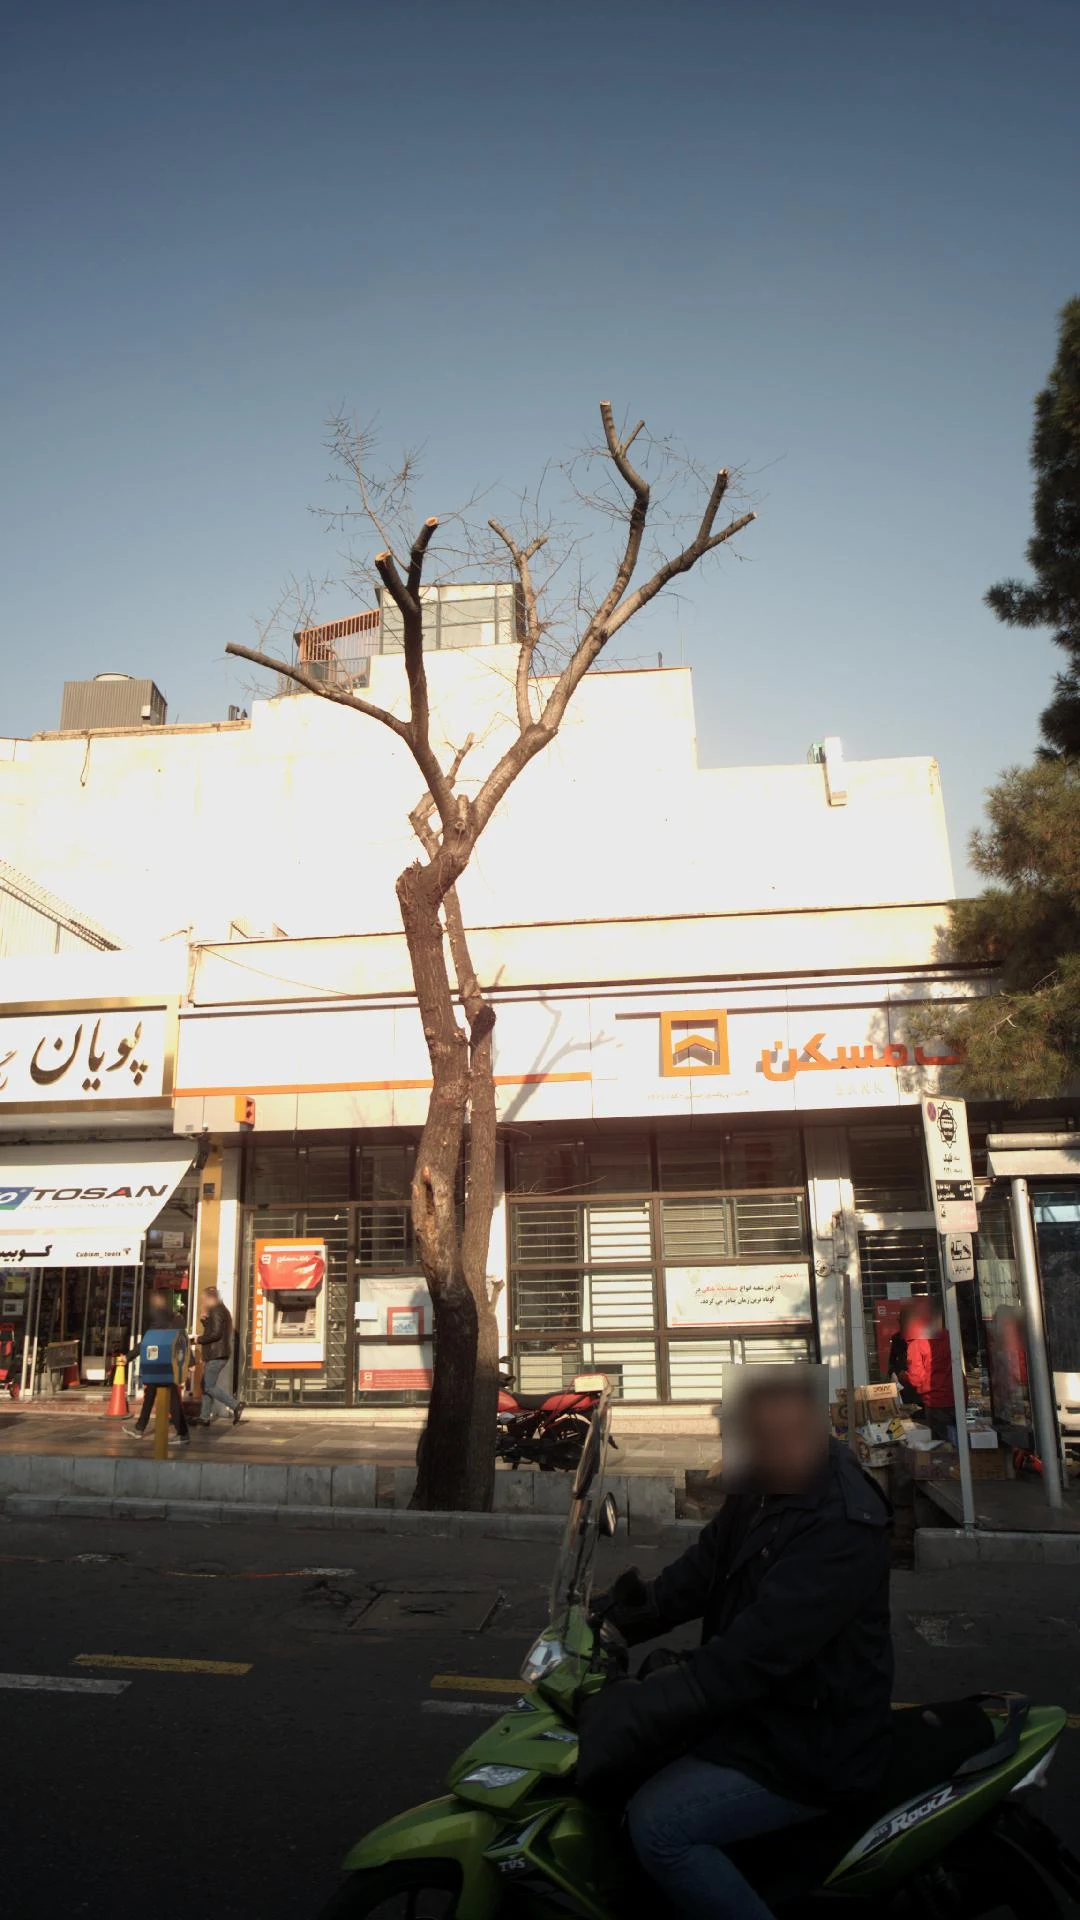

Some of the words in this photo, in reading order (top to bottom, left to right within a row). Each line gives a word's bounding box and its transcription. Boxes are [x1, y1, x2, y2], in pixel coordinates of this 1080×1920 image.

[30, 1016, 148, 1092] پویان
[761, 1033, 908, 1082] مسکن
[33, 1184, 169, 1202] TOSAN
[0, 1244, 53, 1262] کوبی
[738, 1297, 750, 1305] زمان
[763, 1296, 775, 1304] کوتاه
[498, 1859, 526, 1872] TVS
